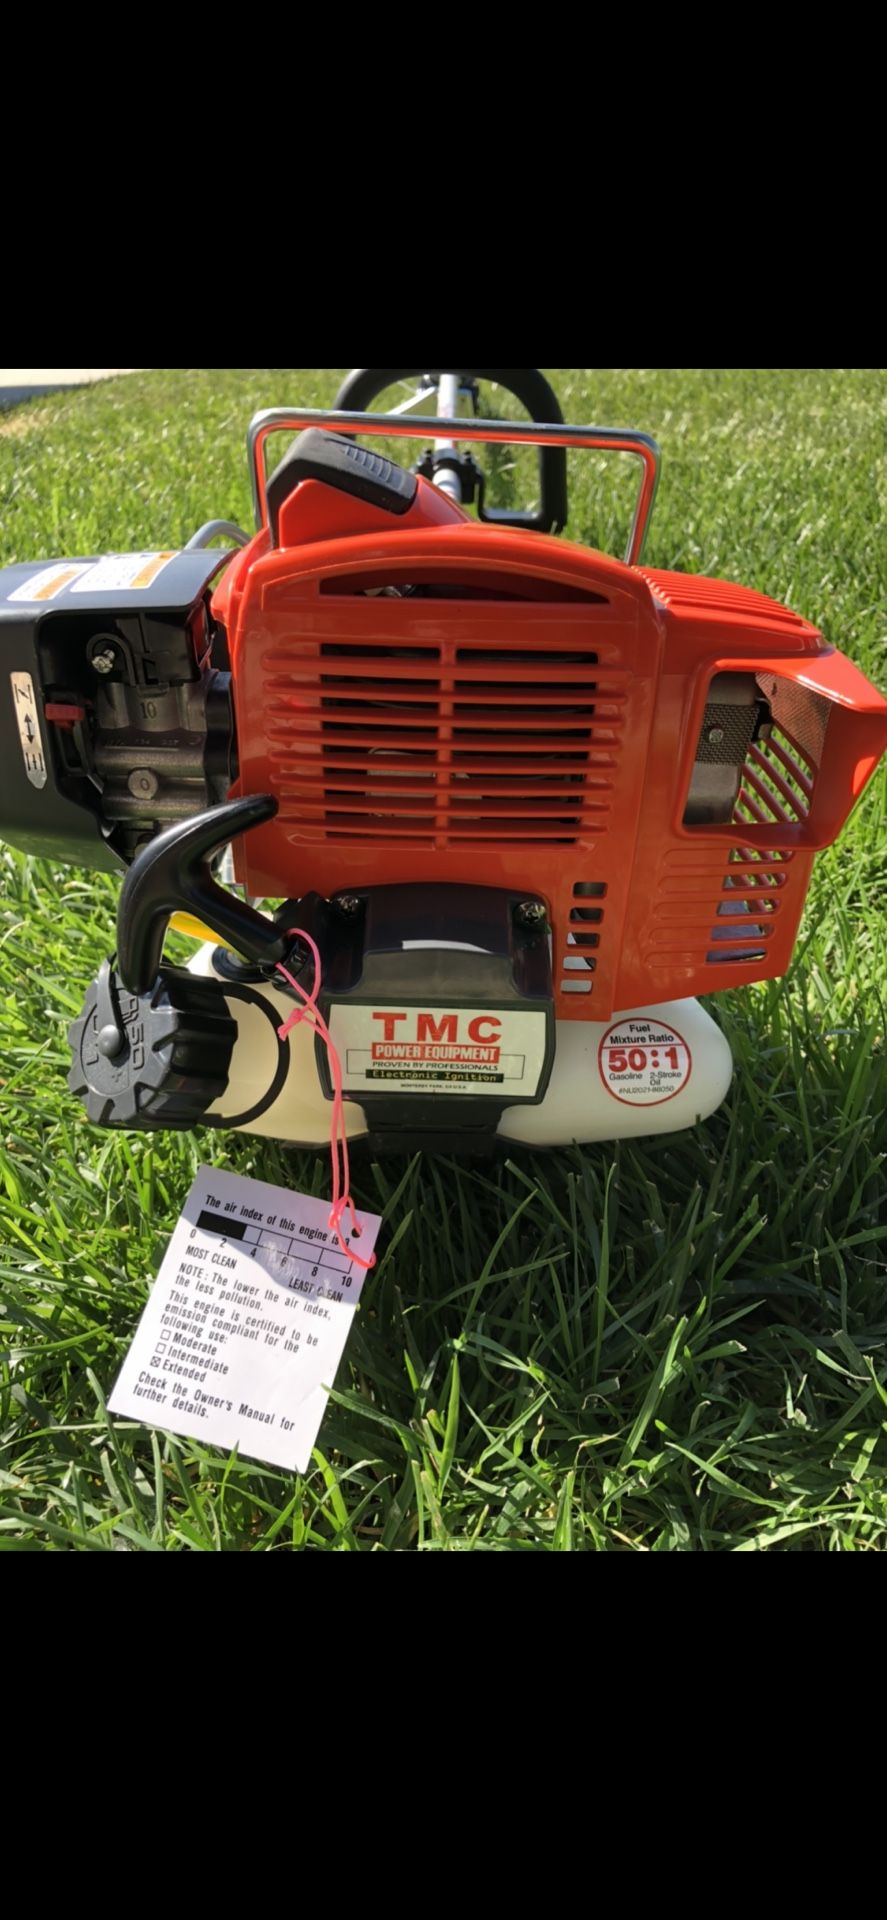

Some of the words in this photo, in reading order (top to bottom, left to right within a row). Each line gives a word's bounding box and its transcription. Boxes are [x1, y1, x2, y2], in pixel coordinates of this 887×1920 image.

[372, 1012, 502, 1044] TMC
[610, 1035, 647, 1045] Mixture
[649, 1034, 674, 1043] Ratio
[629, 1024, 651, 1033] Fuel
[375, 1044, 421, 1059] POWER
[425, 1046, 498, 1061] EQUIPMENT
[608, 1047, 679, 1073] 50:1
[372, 1061, 410, 1069] PROVEN
[412, 1061, 424, 1069] BY
[426, 1062, 498, 1071] PROFESSIONALS
[372, 1070, 439, 1080] Electronic
[445, 1073, 496, 1082] Ignition
[609, 1073, 643, 1081] Gasoline
[649, 1071, 682, 1079] 2-Stroke
[206, 1194, 221, 1209] The
[224, 1200, 237, 1213] air
[240, 1203, 264, 1222] index
[267, 1213, 277, 1225] of
[279, 1217, 296, 1232] this
[299, 1225, 328, 1242] engine
[331, 1231, 340, 1246] is
[189, 1228, 197, 1239] 0
[219, 1238, 227, 1248] 2
[185, 1245, 208, 1260] MOST
[211, 1253, 238, 1269] CLEAN
[250, 1248, 257, 1258] 4
[280, 1256, 288, 1267] 6
[311, 1266, 318, 1277] 8
[341, 1275, 353, 1288] 10
[175, 1274, 192, 1289] the
[195, 1281, 214, 1295] less
[219, 1287, 263, 1311] pollution.
[213, 1272, 228, 1286] The
[233, 1279, 260, 1297] lower
[264, 1289, 279, 1302] the
[285, 1296, 299, 1309] air
[288, 1276, 314, 1293] LEAST
[160, 1313, 203, 1338] following
[208, 1329, 228, 1344] use:
[165, 1302, 207, 1324] emission
[212, 1317, 259, 1341] compliant
[264, 1332, 279, 1347] for
[284, 1338, 299, 1353] the
[170, 1289, 189, 1305] This
[193, 1297, 225, 1317] engine
[231, 1308, 240, 1321] is
[245, 1315, 286, 1336] certified
[291, 1328, 301, 1341] to
[306, 1333, 318, 1347] be
[172, 1333, 217, 1356] Moderate
[162, 1359, 207, 1383] Extended
[167, 1346, 230, 1375] Intermediate
[133, 1383, 168, 1404] further
[172, 1396, 209, 1419] details.
[138, 1371, 166, 1390] Check
[172, 1382, 188, 1397] the
[193, 1389, 233, 1412] Owner's
[238, 1404, 275, 1425] Manual
[280, 1417, 295, 1431] for
